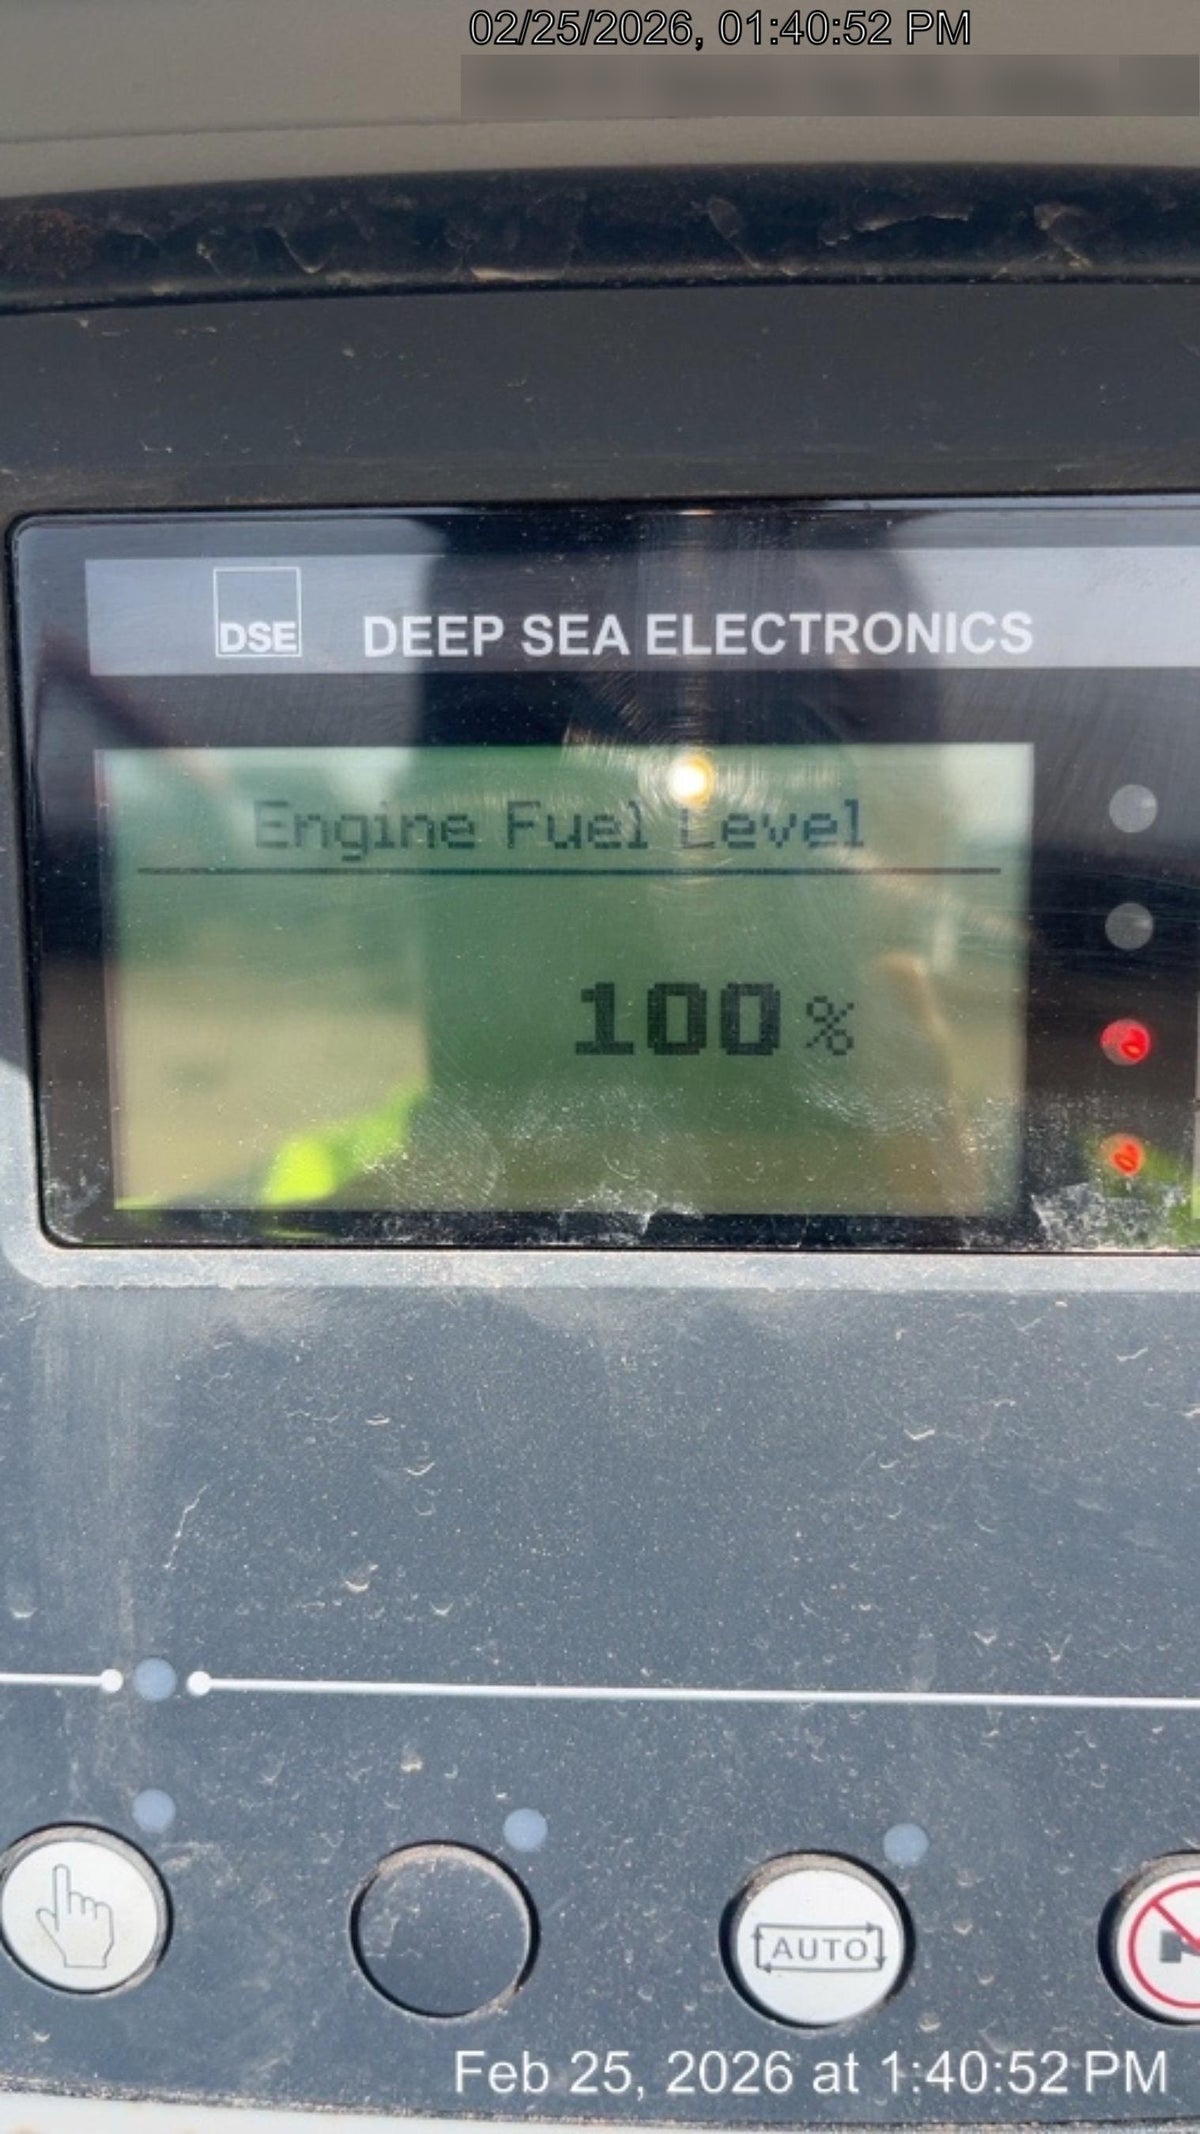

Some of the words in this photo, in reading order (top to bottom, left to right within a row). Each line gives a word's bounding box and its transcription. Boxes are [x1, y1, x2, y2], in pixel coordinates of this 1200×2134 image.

[220, 622, 297, 653] DSE
[364, 615, 503, 657] DEEP
[522, 613, 630, 656] SEA
[647, 611, 1033, 655] ELECTRONICS
[255, 801, 475, 861] Engine
[508, 801, 648, 849] Fuel
[681, 799, 864, 848] Level
[575, 982, 781, 1055] 100
[805, 995, 854, 1055] %
[772, 1936, 868, 1962] AUTO
